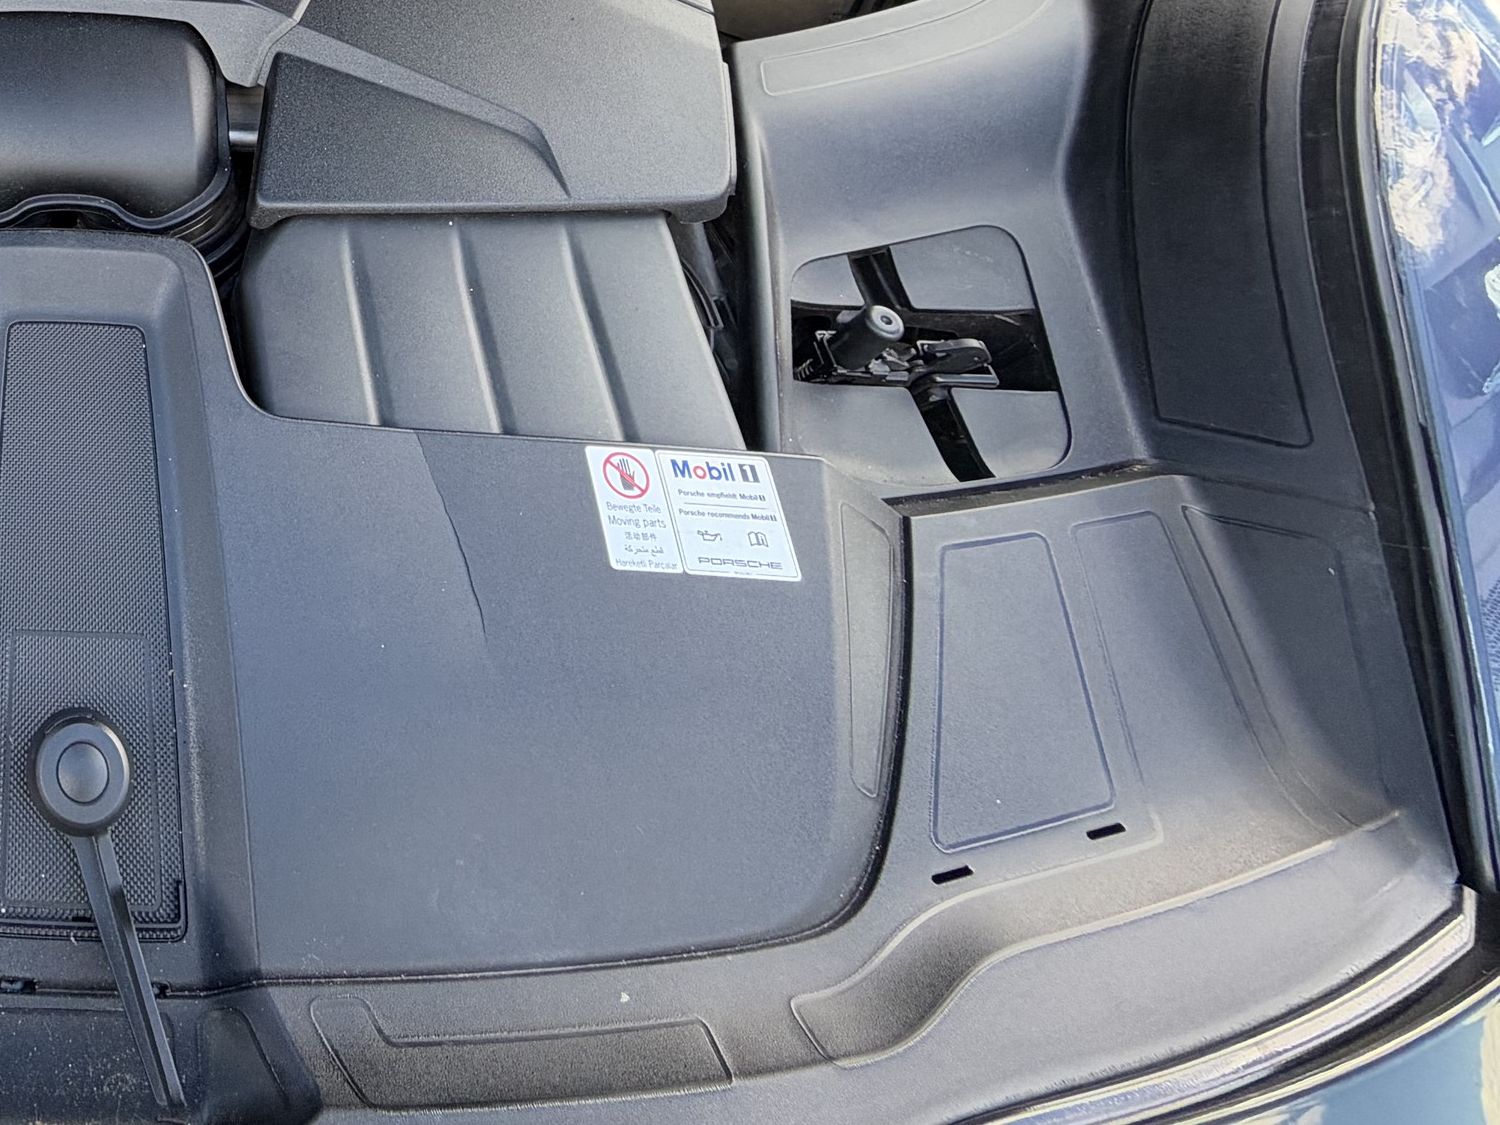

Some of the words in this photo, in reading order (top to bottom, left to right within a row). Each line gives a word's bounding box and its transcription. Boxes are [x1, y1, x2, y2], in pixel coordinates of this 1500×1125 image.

[669, 458, 736, 482] Mobil
[677, 488, 706, 498] Porsche
[738, 493, 759, 501] Mobil
[606, 501, 642, 514] Bewegte
[642, 503, 662, 514] Teile
[678, 508, 706, 517] Porsche
[707, 511, 750, 520] recommends
[750, 513, 770, 521] Mobil
[607, 514, 642, 529] Moving
[642, 518, 667, 529] parts
[697, 556, 784, 570] PORSCHE
